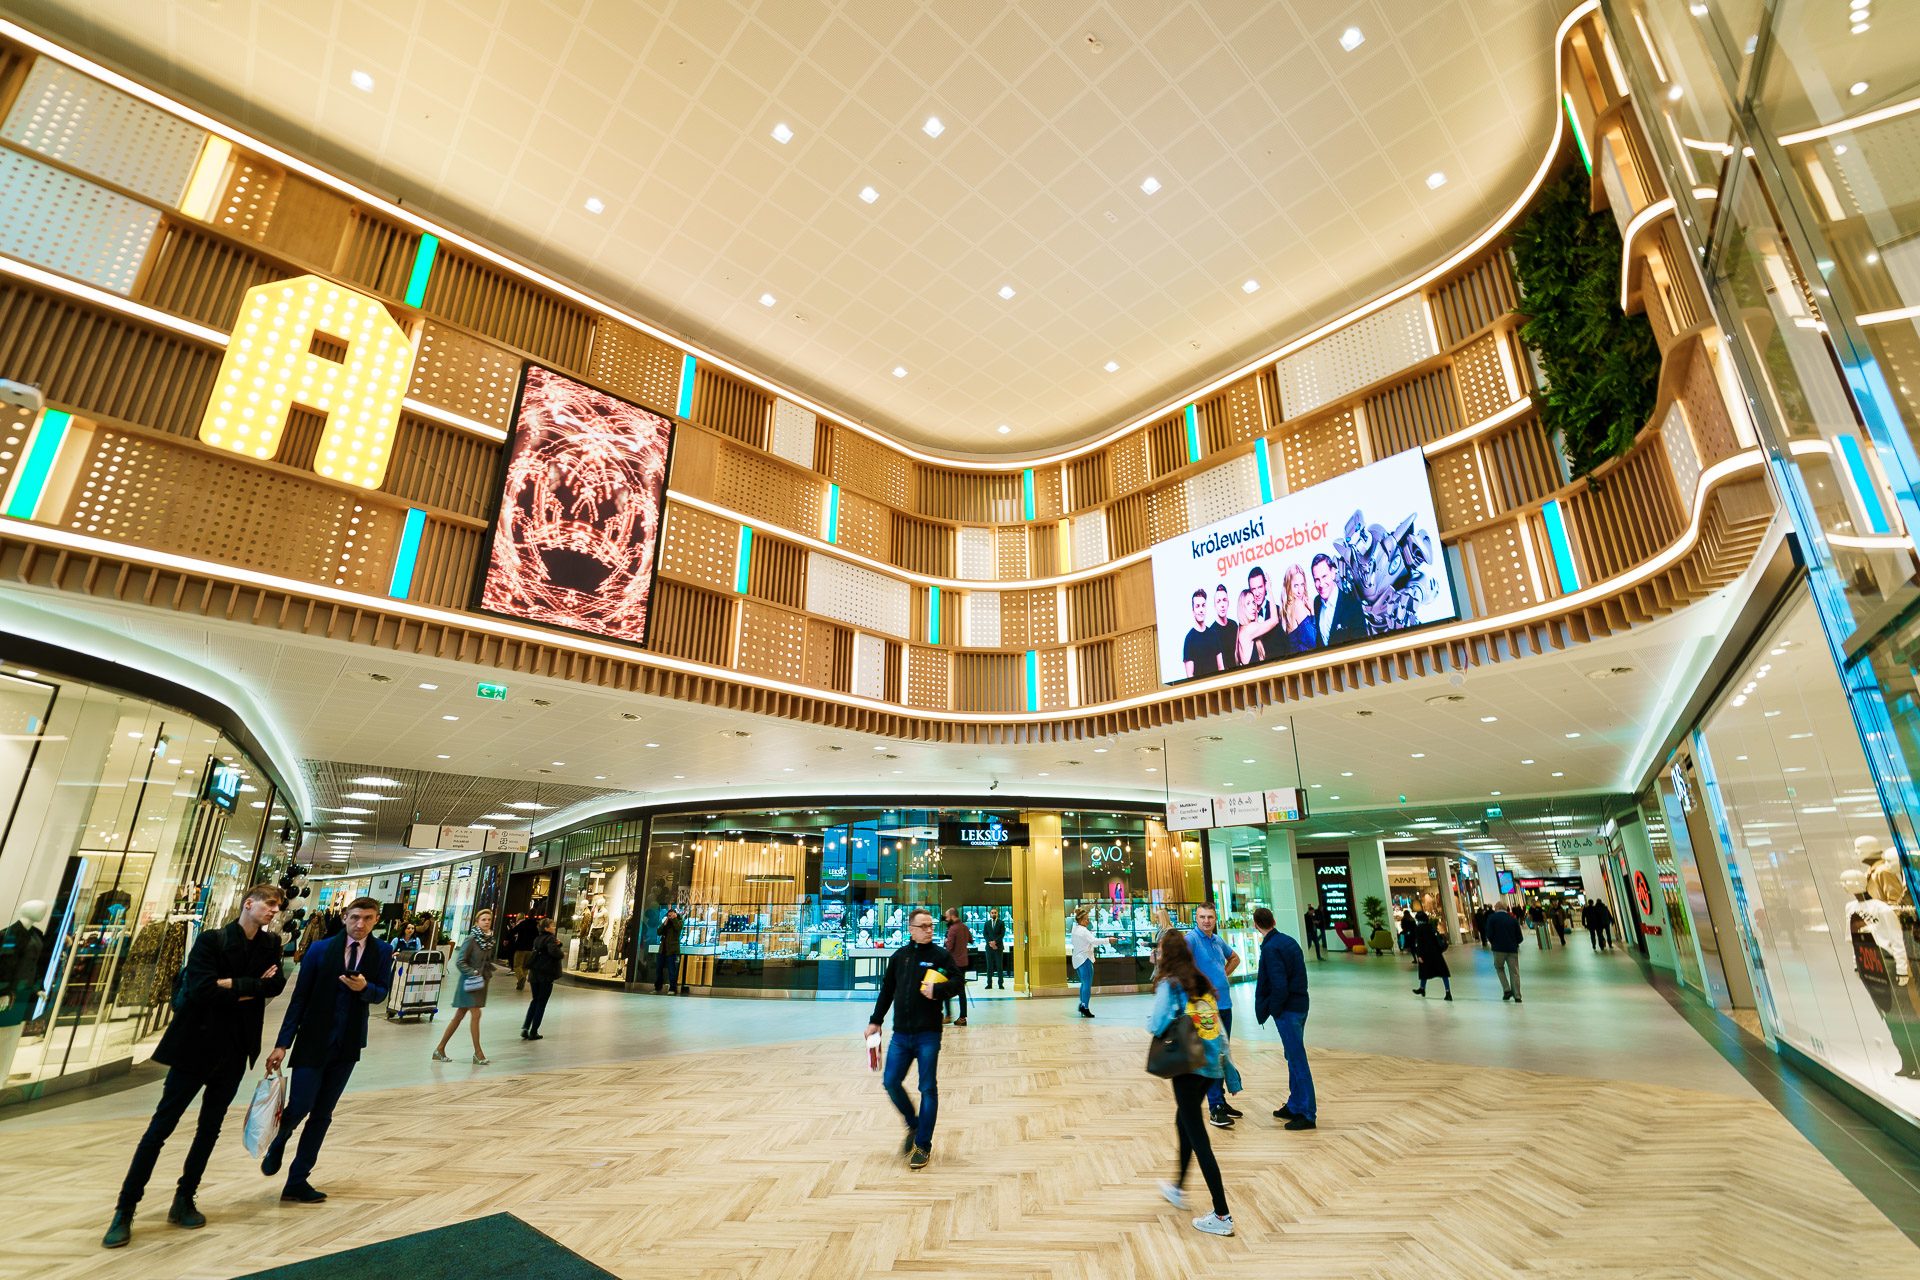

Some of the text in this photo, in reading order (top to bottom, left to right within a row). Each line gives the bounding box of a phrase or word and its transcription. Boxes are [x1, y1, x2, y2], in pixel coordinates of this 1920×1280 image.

[199, 274, 413, 490] A
[1191, 516, 1265, 559] królewski
[1216, 520, 1329, 577] gwiazdozbiór
[961, 829, 1009, 842] LEKSUS
[1317, 865, 1347, 876] APART
[1393, 876, 1418, 885] APART
